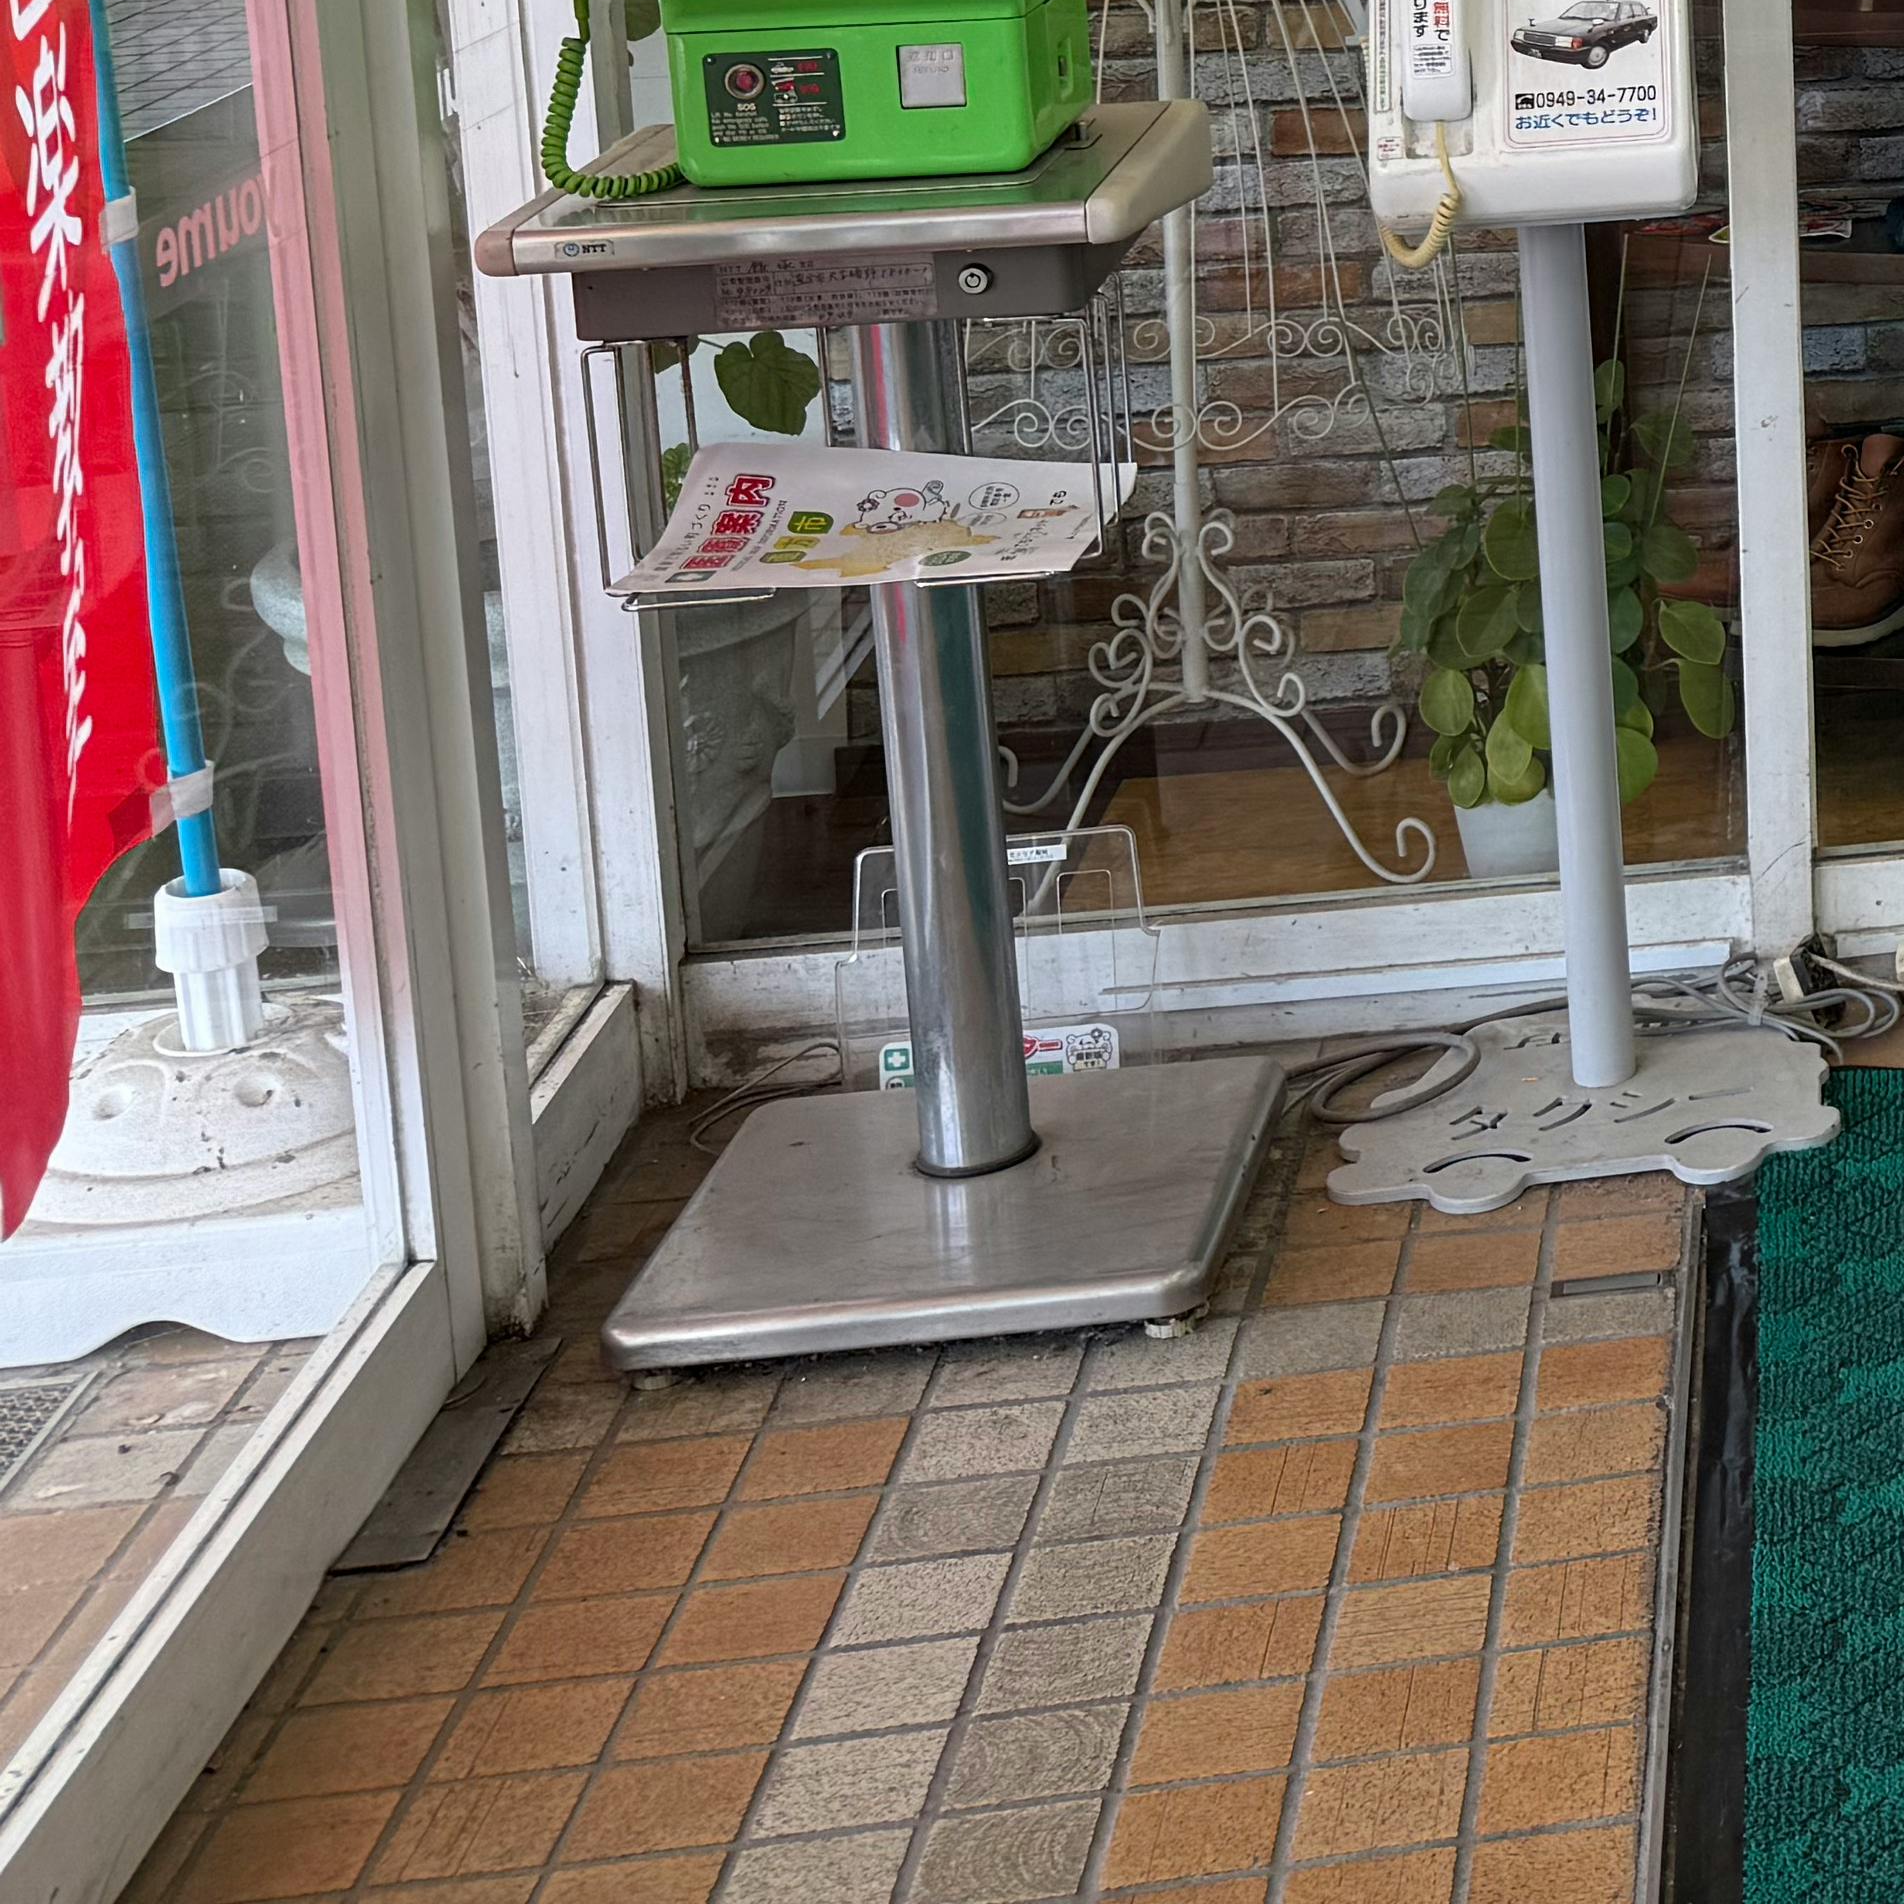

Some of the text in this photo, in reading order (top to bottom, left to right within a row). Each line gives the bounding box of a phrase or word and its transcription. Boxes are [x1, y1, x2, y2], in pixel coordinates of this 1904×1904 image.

[1537, 84, 1656, 108] 0949-34-7700
[582, 243, 607, 254] NTT
[1449, 1087, 1754, 1140] タクシー
